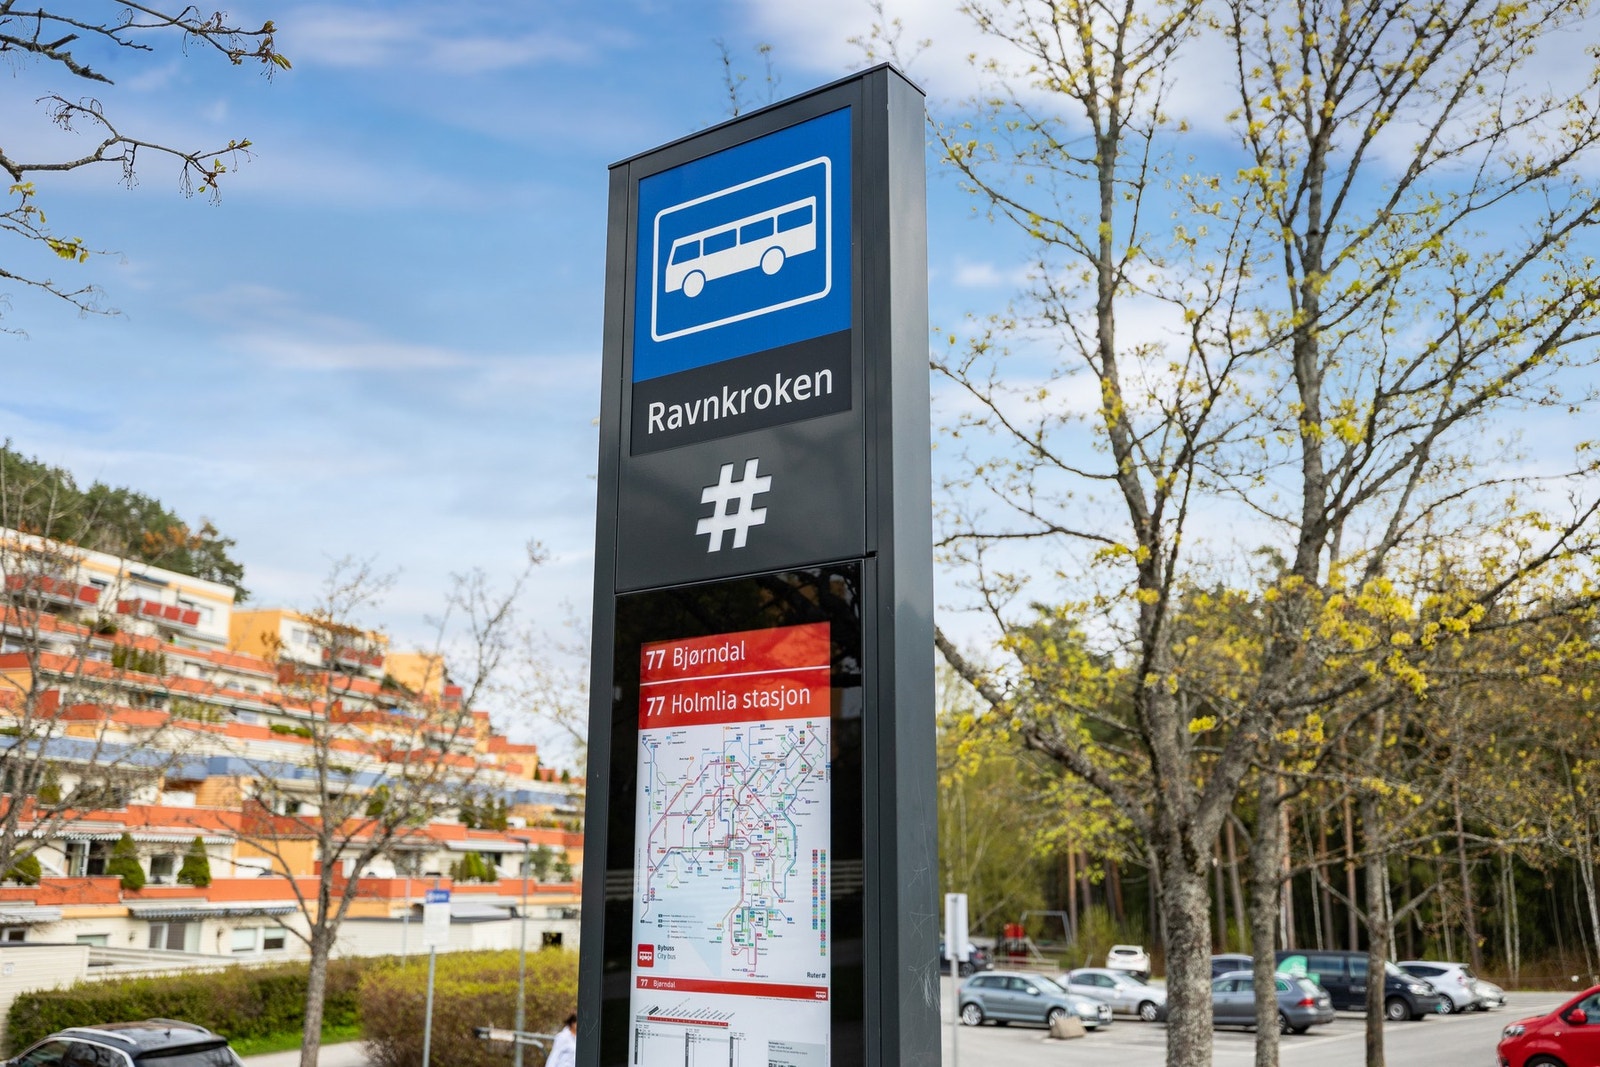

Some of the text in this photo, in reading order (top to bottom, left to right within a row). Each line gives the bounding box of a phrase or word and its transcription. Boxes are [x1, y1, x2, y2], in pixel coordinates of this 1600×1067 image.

[647, 368, 833, 434] Ravnkroken
[695, 458, 772, 553] #
[645, 640, 746, 671] 77 Bjørndal
[646, 685, 811, 717] 77 Holmlia stasjon
[657, 944, 675, 952] Bybuss
[657, 952, 667, 960] City
[640, 978, 676, 989] 77 Bjørndal
